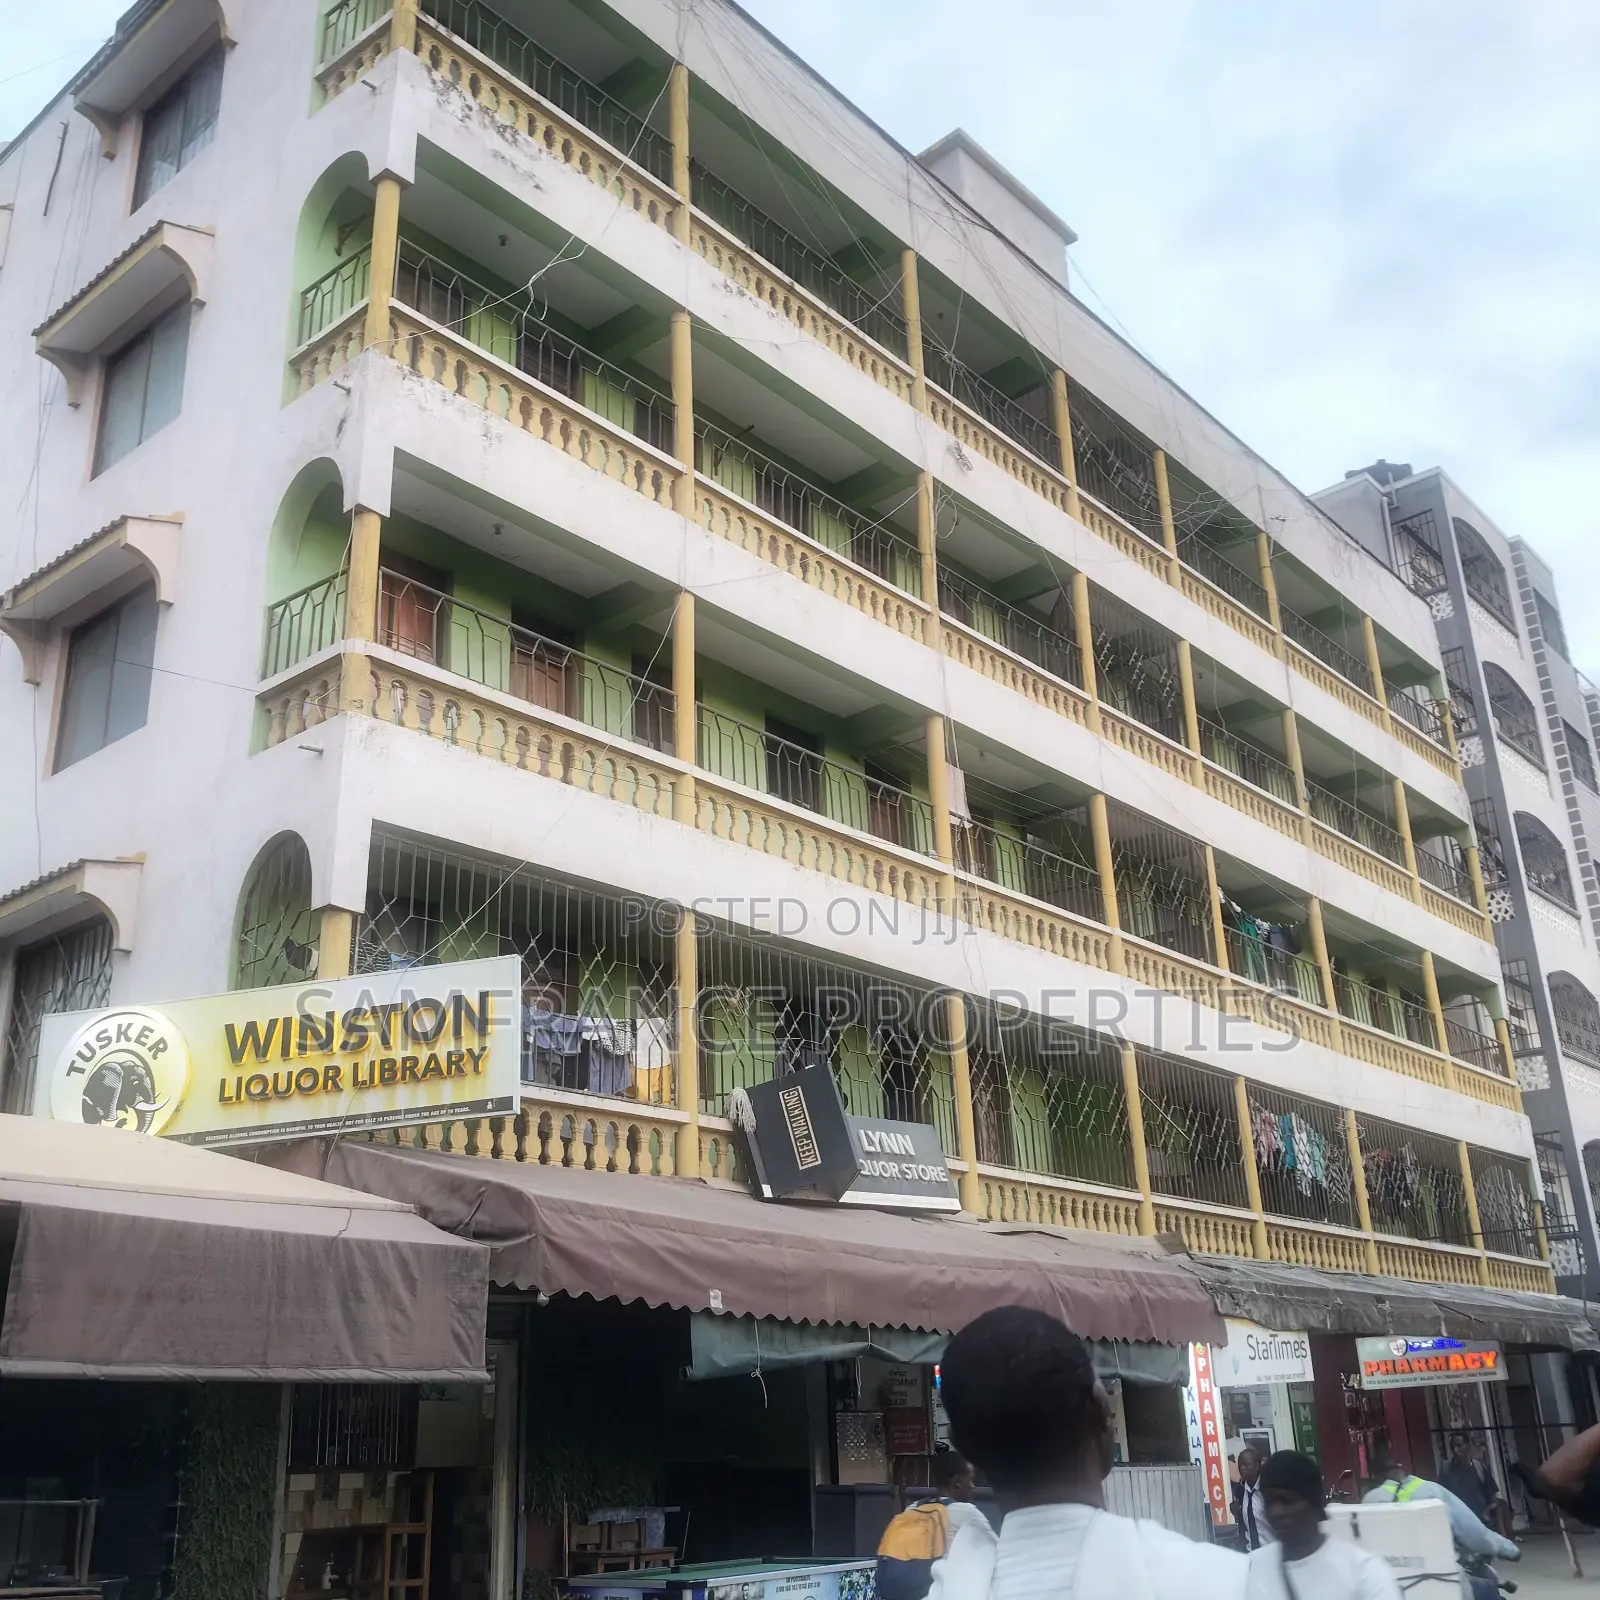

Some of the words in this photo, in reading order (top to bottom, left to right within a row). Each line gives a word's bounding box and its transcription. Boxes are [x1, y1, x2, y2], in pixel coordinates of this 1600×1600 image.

[224, 990, 492, 1065] WINSTON
[65, 1022, 170, 1078] TUSKER
[218, 1067, 344, 1104] LIQUOR
[351, 1046, 490, 1088] LIBRARY
[784, 1089, 807, 1137] WALKING
[798, 1136, 816, 1166] KEEP
[858, 1129, 916, 1157] LYNN
[860, 1159, 901, 1179] QUOR
[901, 1162, 948, 1183] STORE
[1246, 1333, 1308, 1361] StarTimes
[1363, 1350, 1498, 1377] PHARMACY
[1197, 1357, 1223, 1523] PHARMACY
